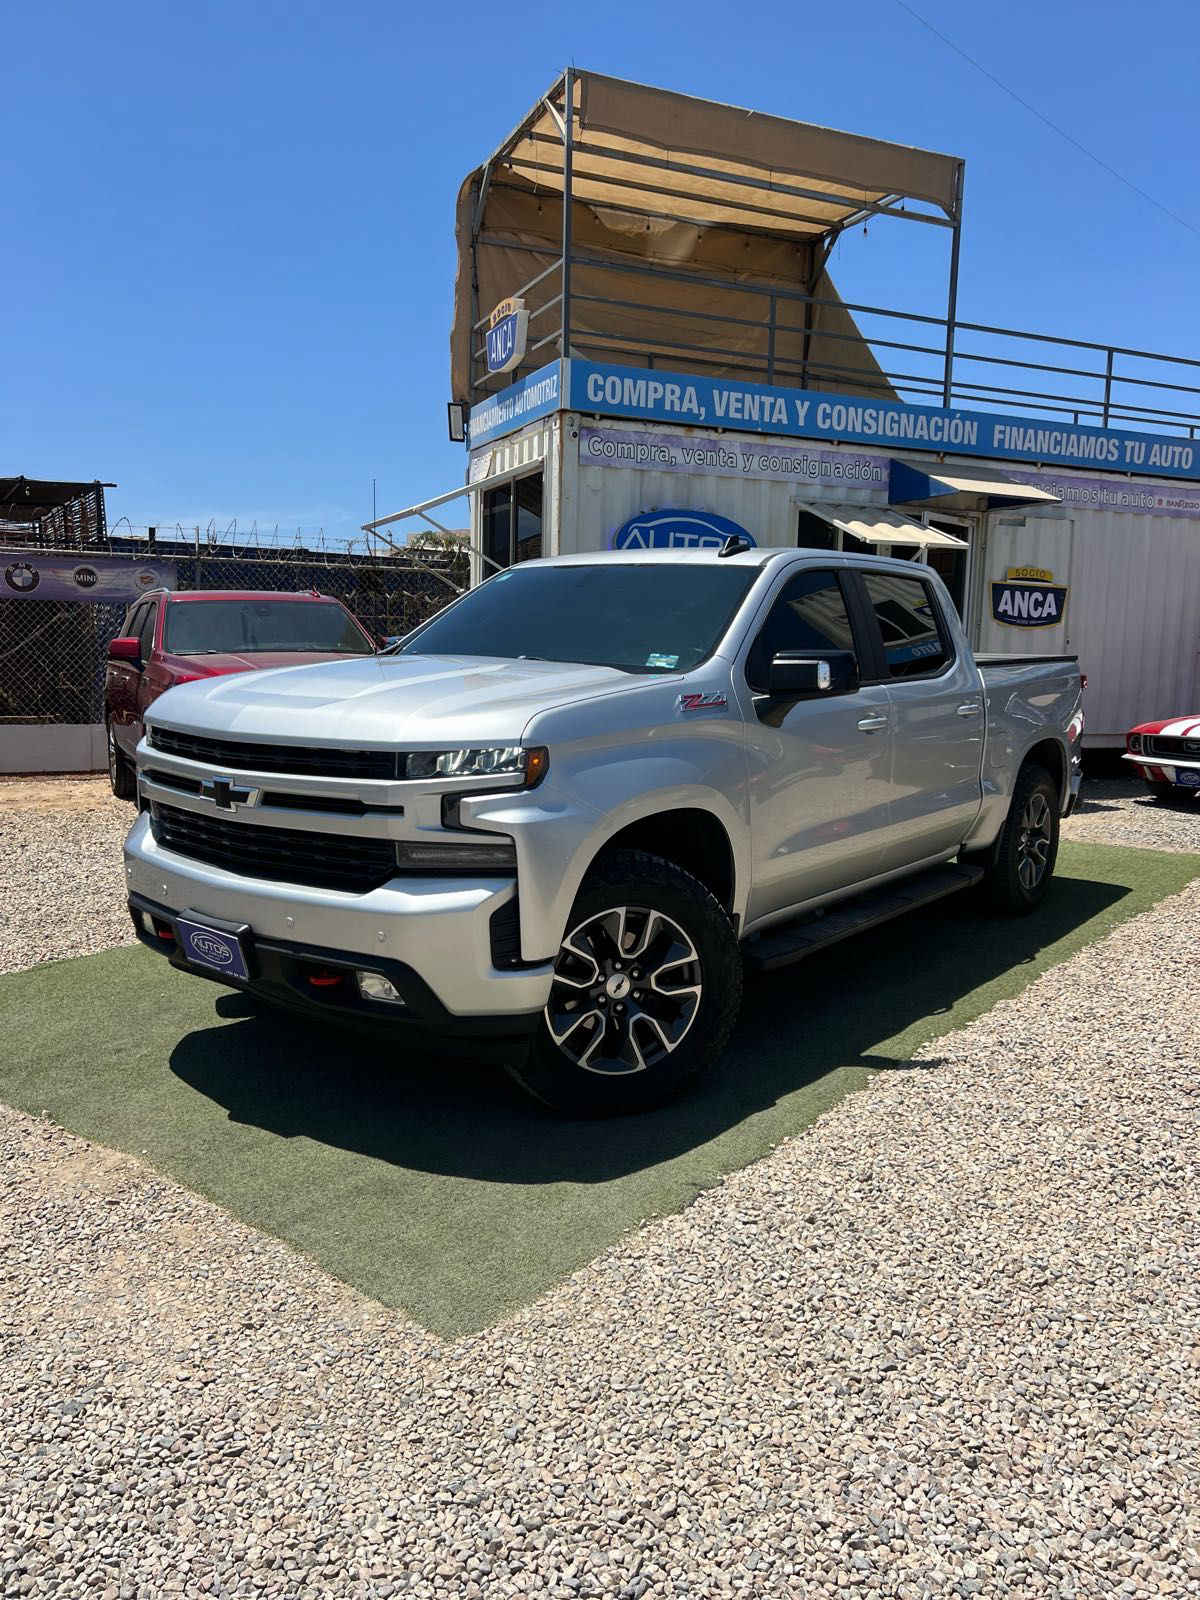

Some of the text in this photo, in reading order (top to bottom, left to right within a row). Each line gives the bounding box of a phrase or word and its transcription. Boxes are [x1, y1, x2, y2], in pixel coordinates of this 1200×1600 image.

[491, 321, 512, 362] ANCA
[514, 374, 558, 417] AUTOMOTRIZ
[586, 373, 978, 446] COMPRA, VENTA Y CONSIGNACIÓN
[588, 435, 882, 482] Compra, venta y consignación
[993, 424, 1193, 470] FINANCIAMOS TU AUTO
[1102, 488, 1117, 505] tu
[1121, 491, 1153, 509] auto
[622, 527, 748, 550] AUTO
[75, 573, 97, 584] MINI
[1015, 568, 1047, 578] SOCIO
[998, 590, 1057, 618] ANCA
[193, 936, 230, 957] AUTOS
